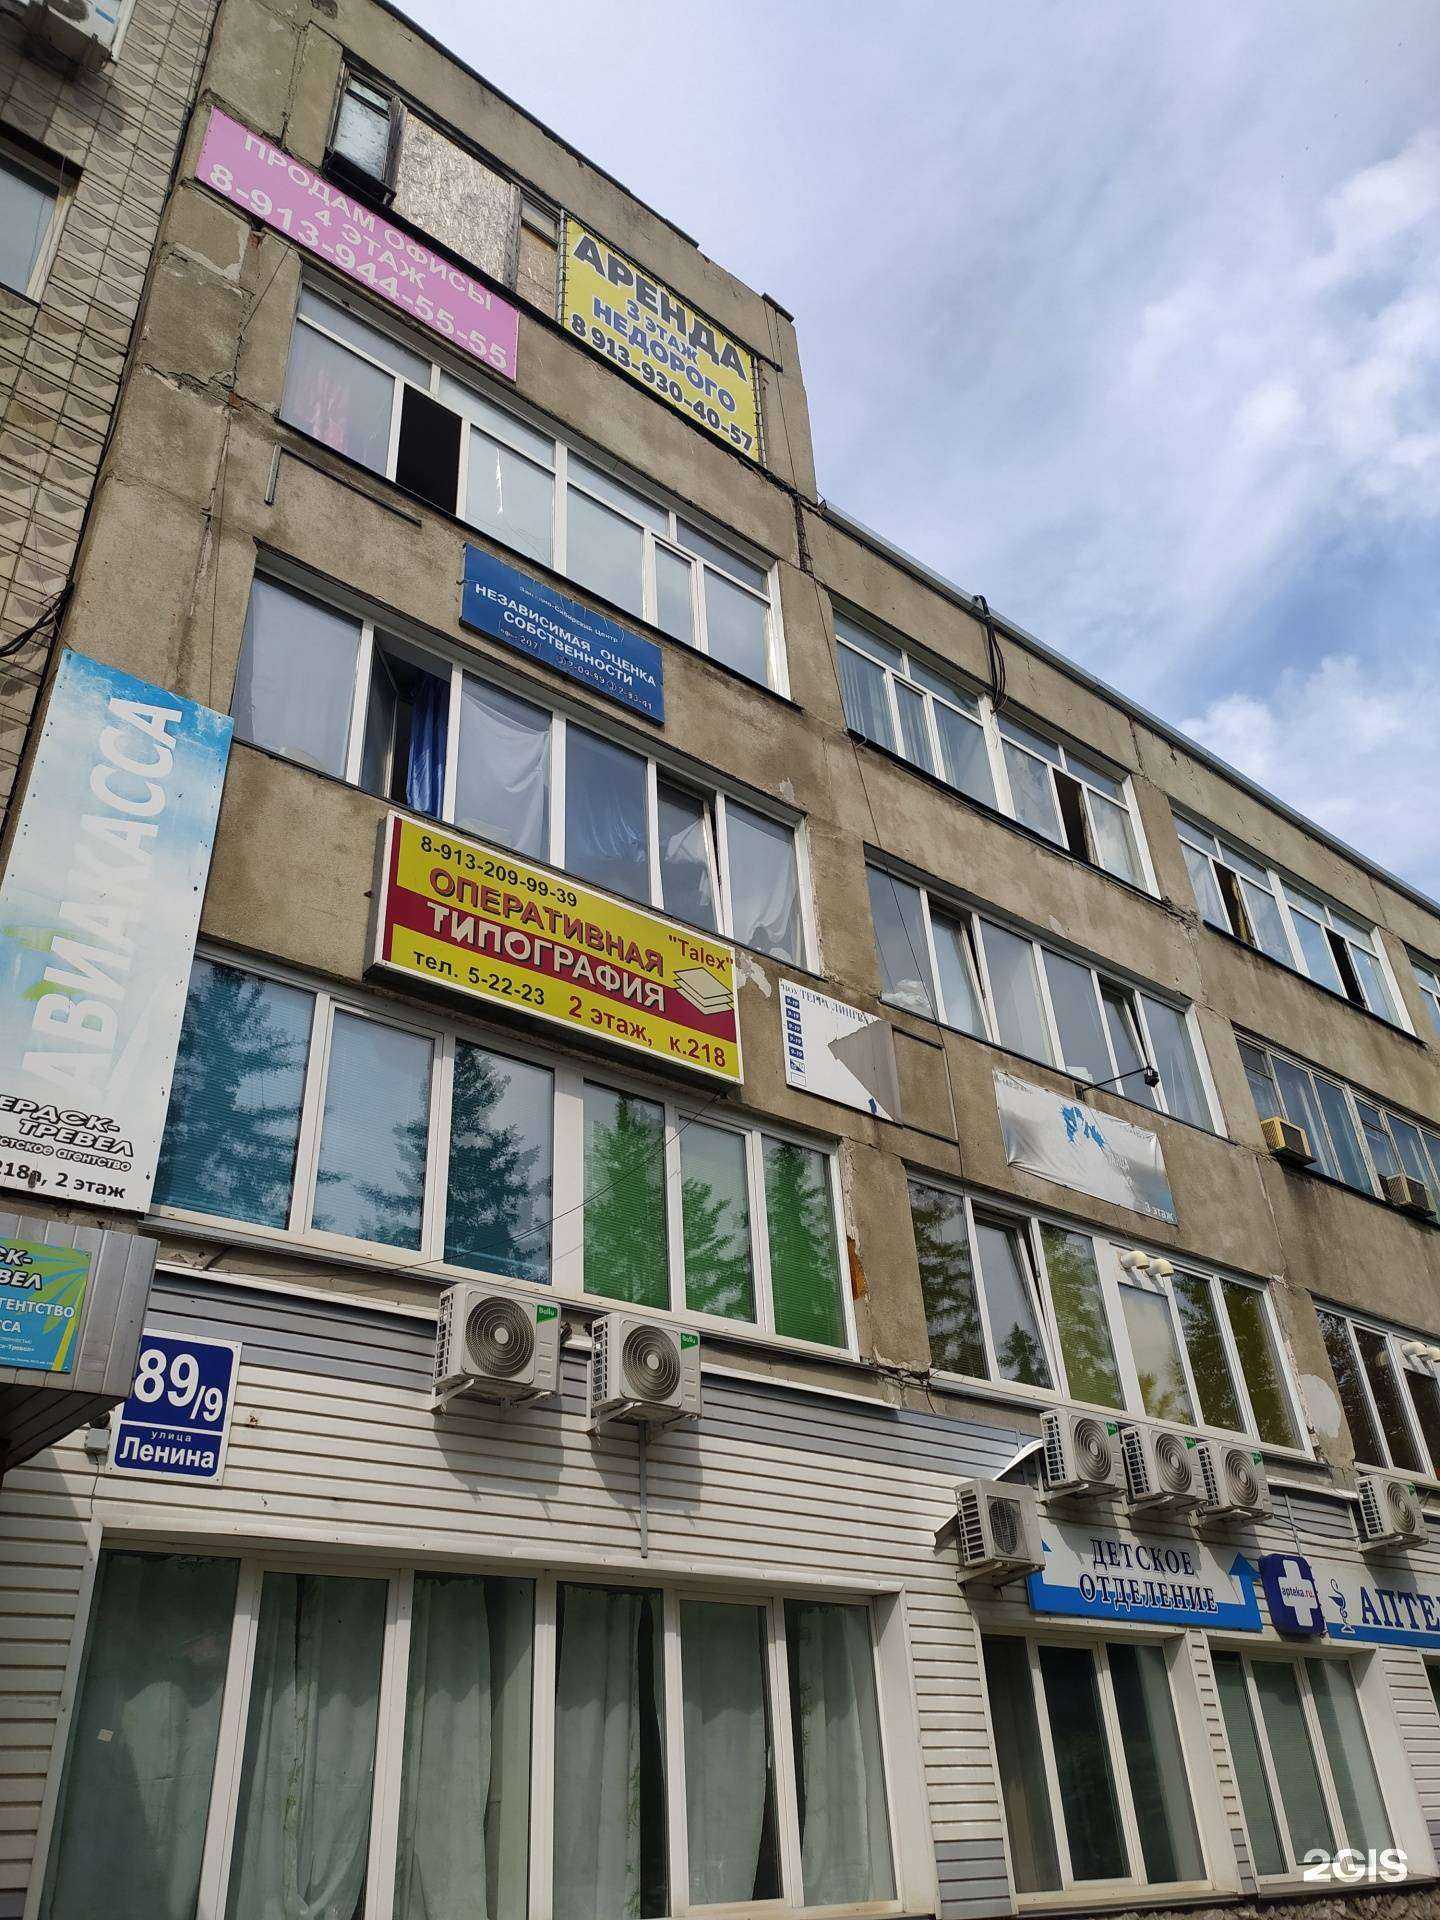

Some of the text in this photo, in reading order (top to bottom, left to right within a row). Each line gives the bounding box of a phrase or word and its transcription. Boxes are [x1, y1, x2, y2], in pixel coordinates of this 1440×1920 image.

[243, 134, 493, 311] ПРОДАМ ОФИСЫ
[314, 209, 426, 289] 4 ЭТАЖ
[209, 163, 508, 370] 8-913-944-55-55
[573, 235, 748, 383] АРЕНДА
[626, 299, 698, 365] 3 ЭТАЖ
[571, 313, 753, 452] 8 913-930-40-57
[593, 297, 736, 413] НЕДОРОГО
[475, 583, 657, 687] НЕЗАВИСИМАЯ ОЦЕНКА
[503, 611, 633, 686] СОБСТВЕННОСТИ
[421, 835, 577, 907] 8-913-209-99-39
[426, 901, 666, 1012] ТИПОГРАФИЯ
[429, 867, 664, 978] ОПЕРАТИВНАЯ
[668, 934, 734, 972] "Talex"
[413, 950, 726, 1068] тел. 5-22-23 2 этаж, к.218
[19, 1118, 134, 1158] ТРЕВЕЛ
[56, 1148, 132, 1172] агентство
[55, 1172, 69, 1188] 2
[73, 1178, 126, 1199] этаж
[134, 1348, 223, 1422] 89/9
[119, 1436, 216, 1469] Ленина
[151, 1430, 192, 1443] улица
[1078, 1573, 1219, 1614] ОТДЕЛЕНИЕ
[1089, 1537, 1197, 1578] ДЕТСКОЕ
[1360, 1586, 1440, 1632] АПТЕ
